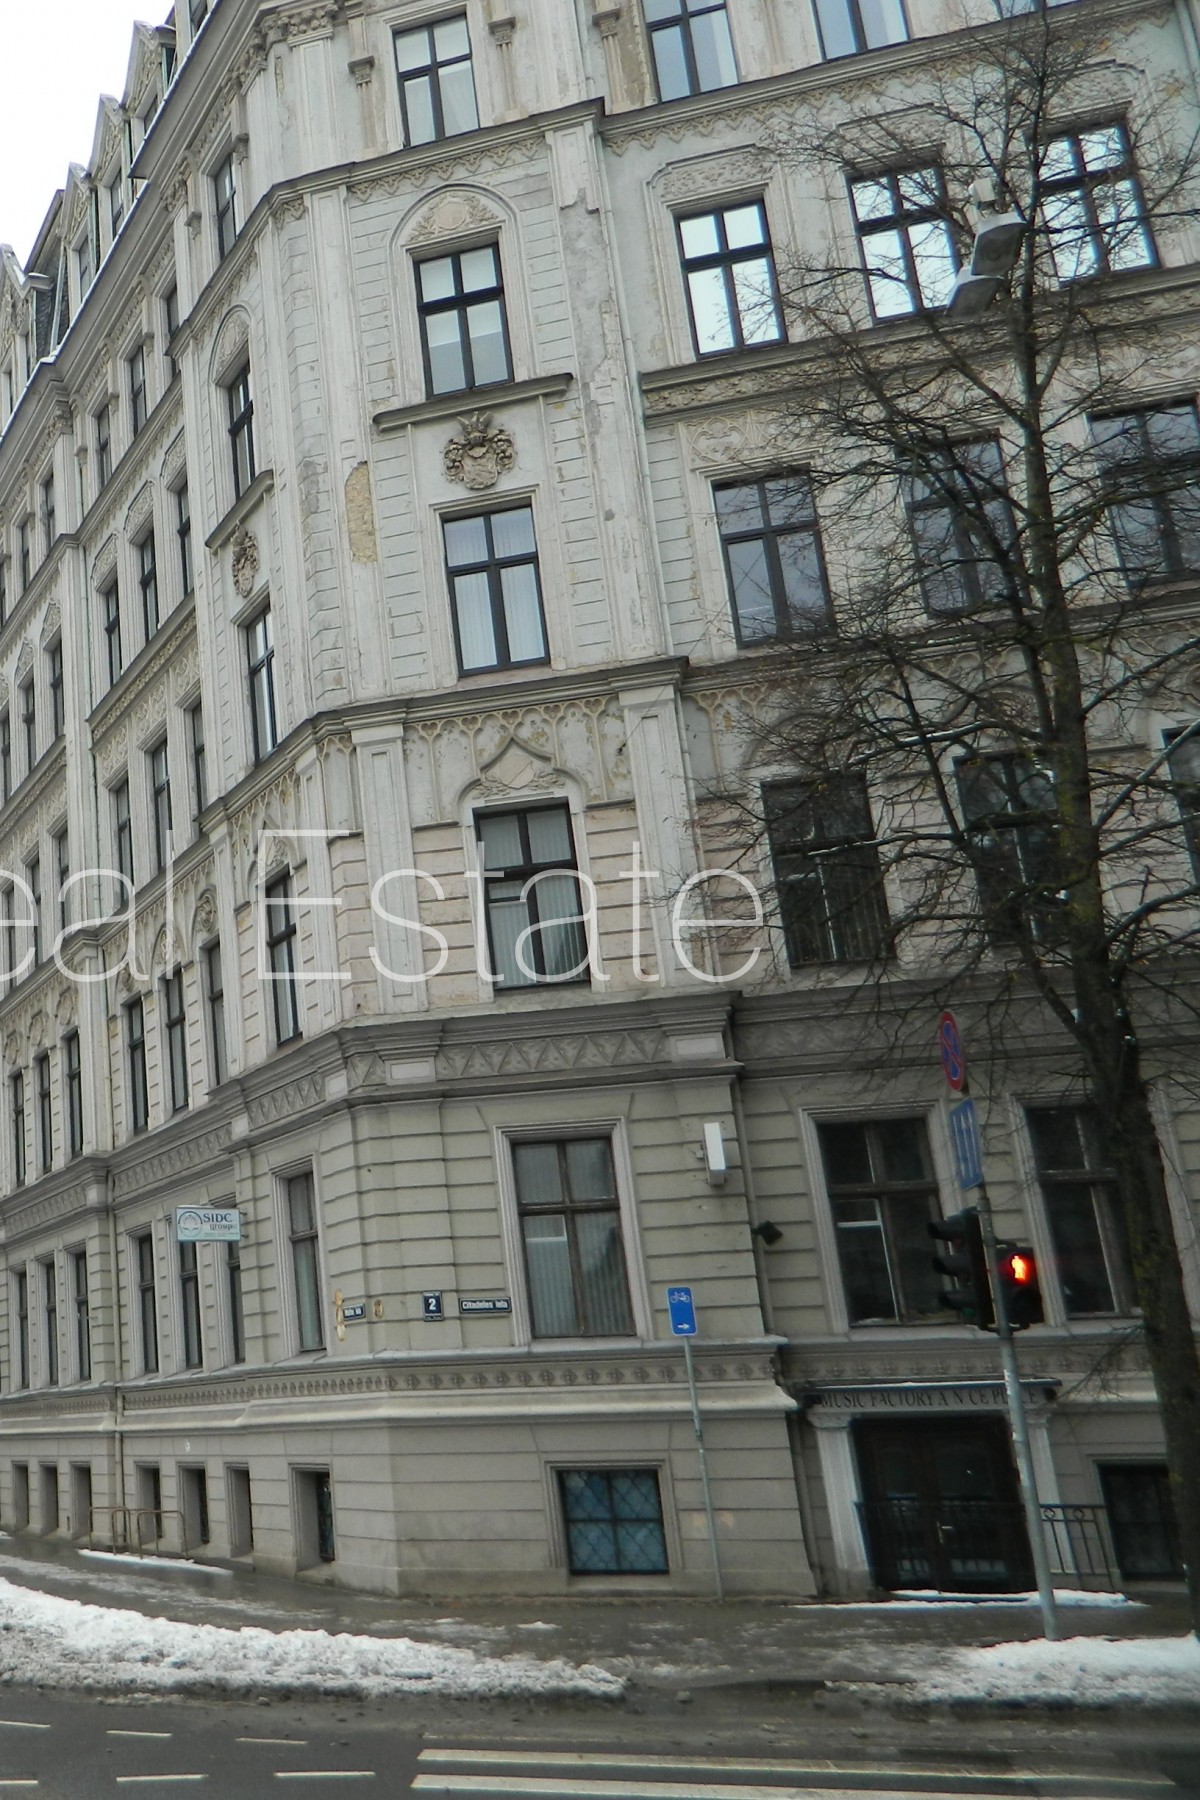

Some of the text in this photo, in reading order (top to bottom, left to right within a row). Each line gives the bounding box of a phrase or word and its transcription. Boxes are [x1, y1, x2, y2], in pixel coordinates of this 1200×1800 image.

[203, 1213, 232, 1223] SIDC
[210, 1223, 233, 1231] group
[428, 1297, 436, 1310] 2
[822, 1391, 865, 1408] MUSIC
[870, 1390, 934, 1407] FACTORY
